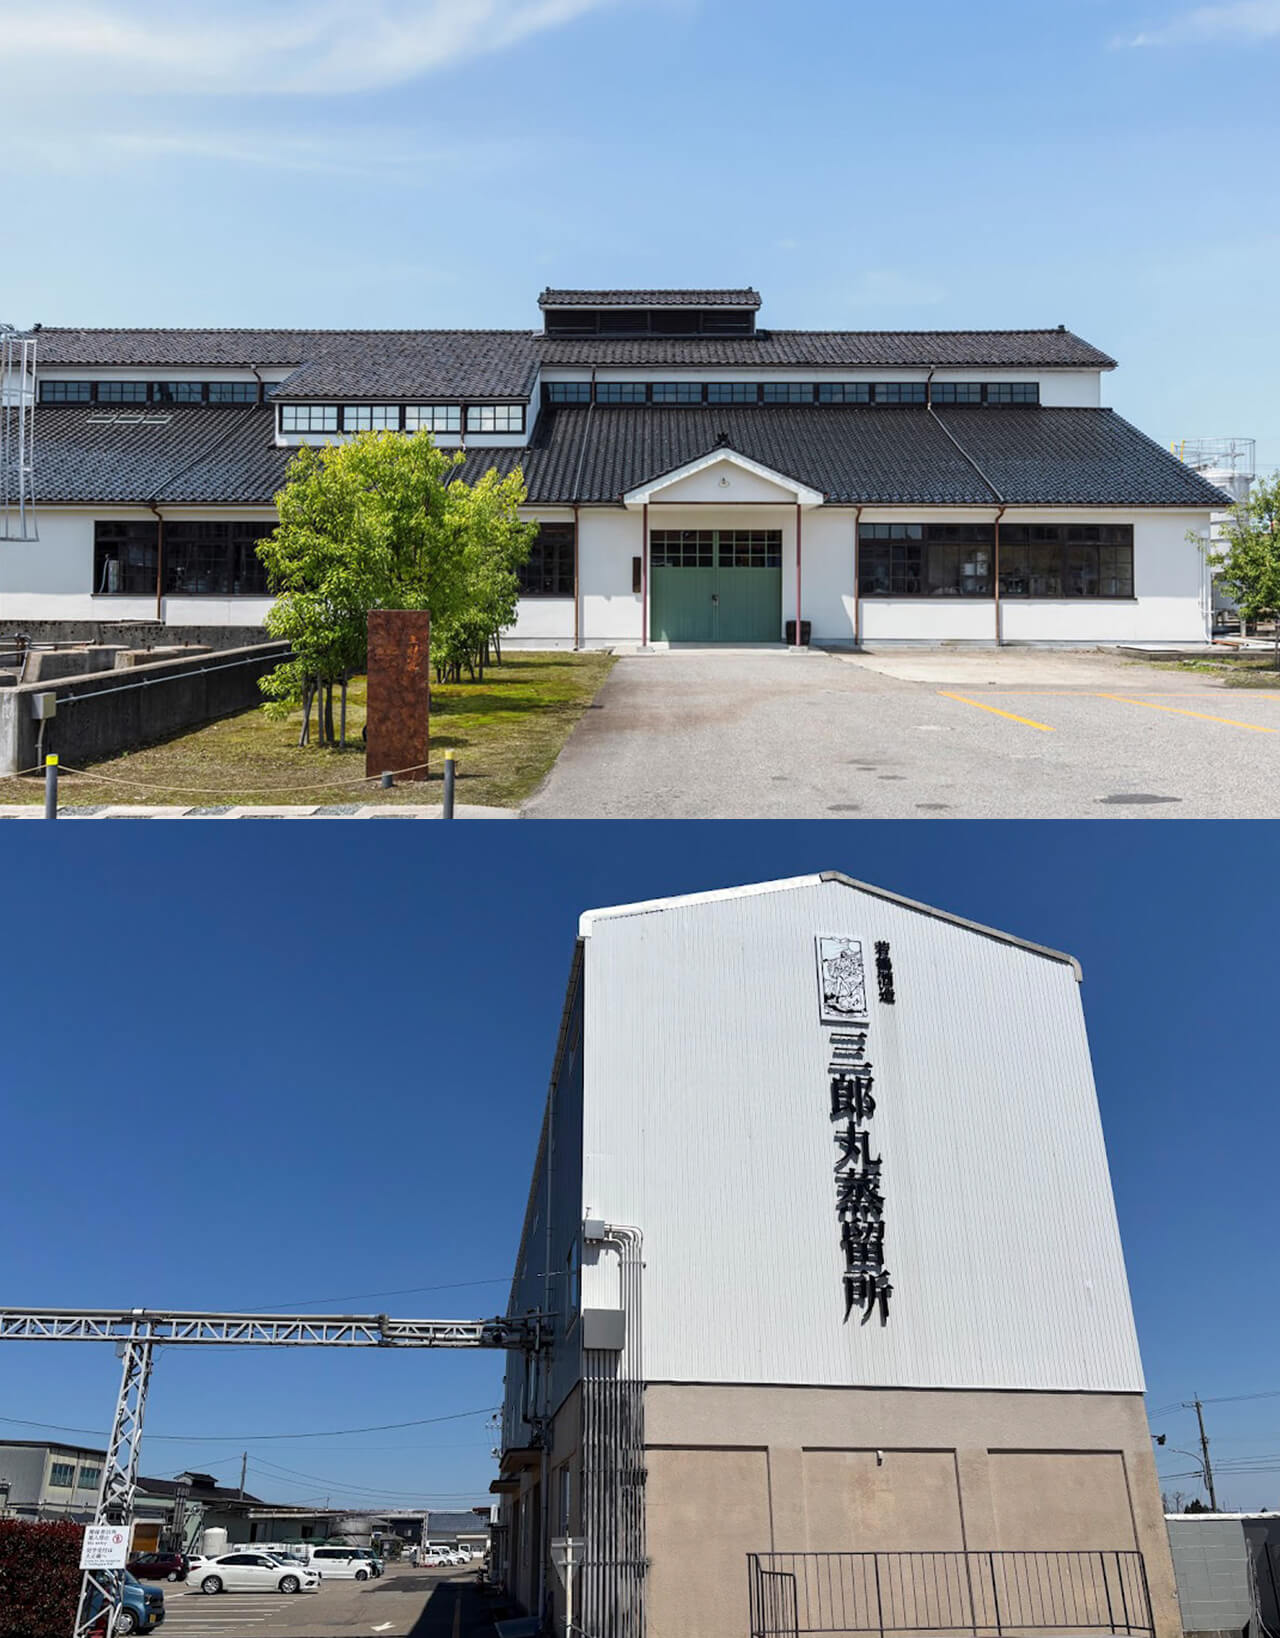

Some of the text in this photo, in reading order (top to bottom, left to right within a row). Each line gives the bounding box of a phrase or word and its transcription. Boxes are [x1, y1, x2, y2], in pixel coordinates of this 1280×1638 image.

[828, 1032, 894, 1327] 三郎丸蒸留所
